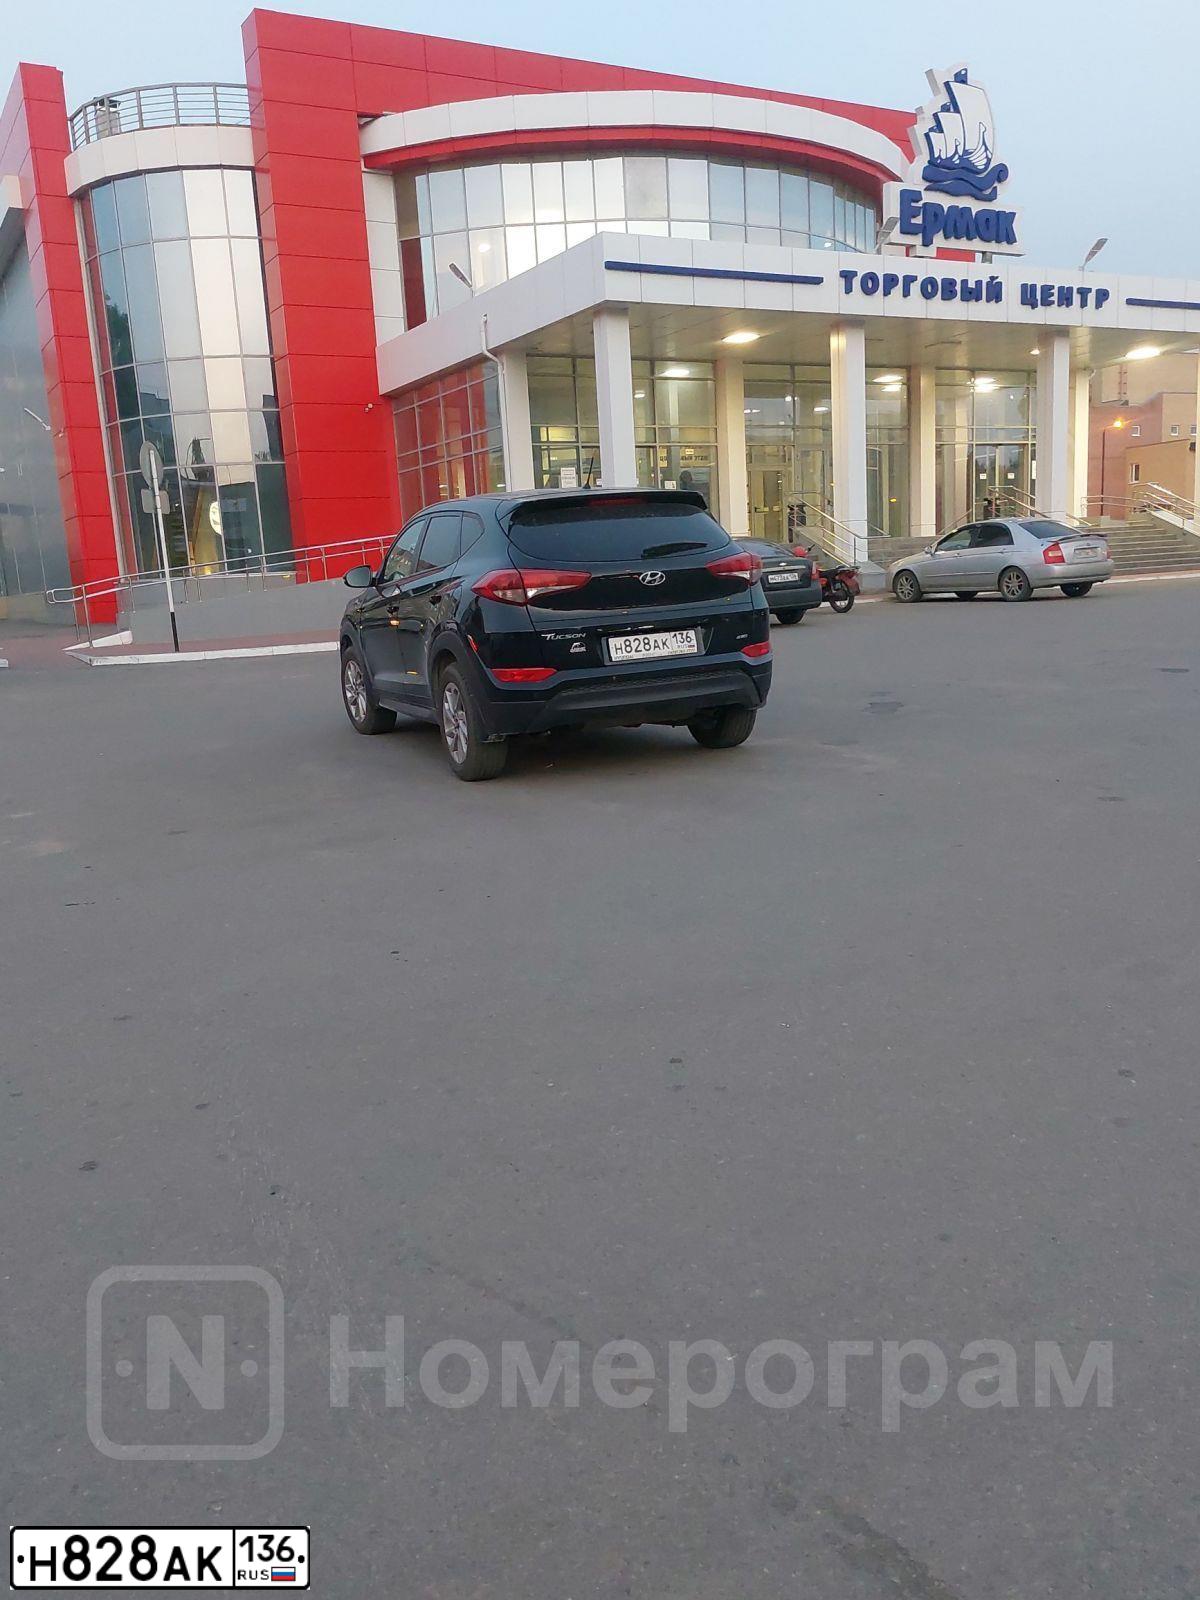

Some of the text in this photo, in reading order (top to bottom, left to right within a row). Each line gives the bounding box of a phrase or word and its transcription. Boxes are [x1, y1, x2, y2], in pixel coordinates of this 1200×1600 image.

[899, 187, 1018, 247] Ермак
[839, 268, 1110, 310] ТОРГОВЫЙ ЦЕНТР
[614, 636, 670, 655] Н828АК
[672, 631, 693, 645] 136
